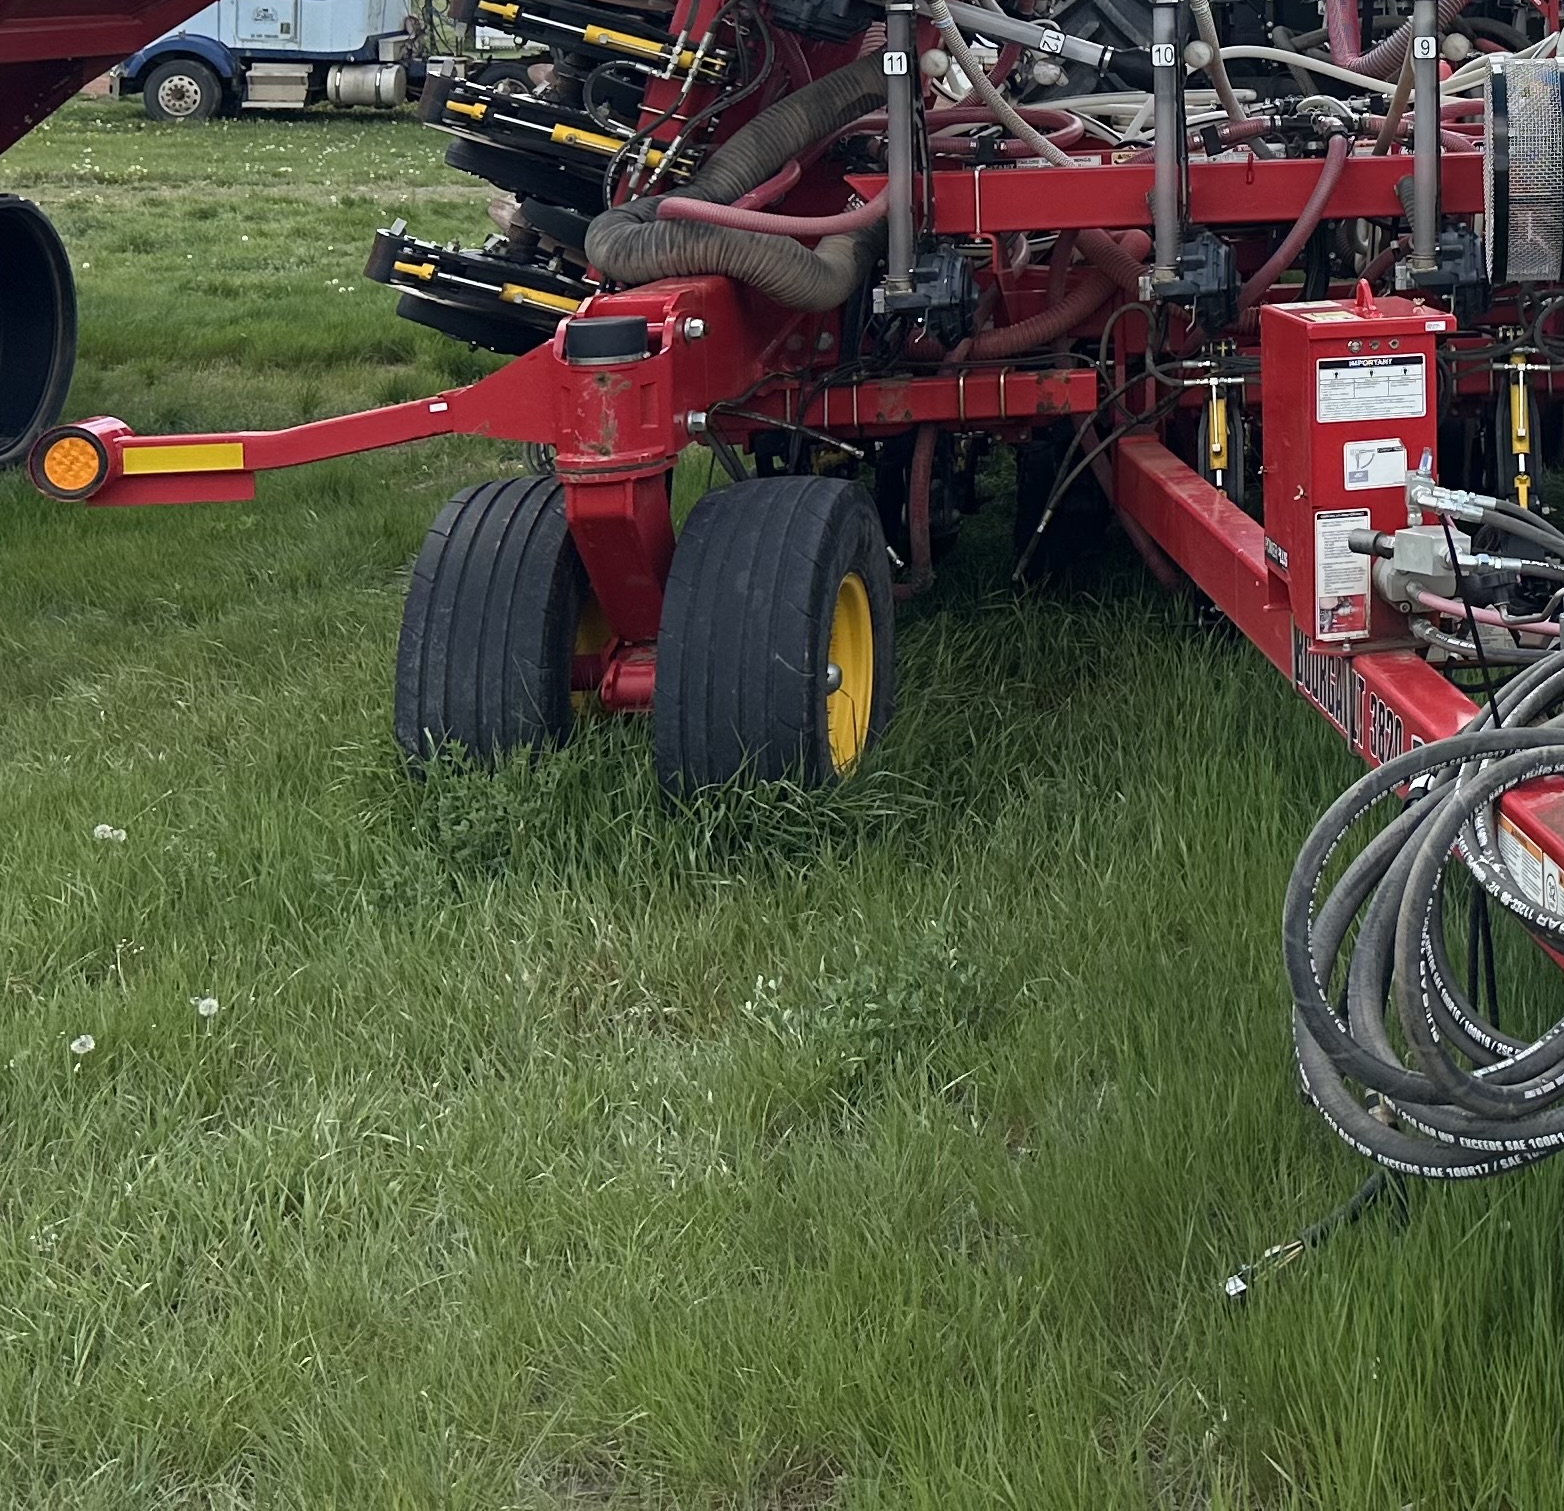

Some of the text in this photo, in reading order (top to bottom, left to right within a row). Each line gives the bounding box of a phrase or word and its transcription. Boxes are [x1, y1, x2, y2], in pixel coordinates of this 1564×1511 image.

[1042, 34, 1060, 52] 12
[1420, 39, 1430, 56] 9
[887, 55, 903, 72] 11
[1155, 47, 1174, 63] 10
[1349, 358, 1393, 367] IMPORTANT
[1369, 691, 1405, 765] 3820
[1440, 989, 1461, 1021] 100R16
[1464, 1020, 1491, 1051] 100R19
[1496, 1042, 1514, 1058] 2SC
[1418, 1121, 1438, 1139] BAR
[1459, 1136, 1505, 1152] EXCEEDS
[1504, 1139, 1527, 1153] SAE
[1377, 1153, 1421, 1176] EXCEEDS
[1422, 1166, 1445, 1178] SAE
[1445, 1162, 1490, 1178] 100R17
[1500, 1151, 1525, 1170] SAE
